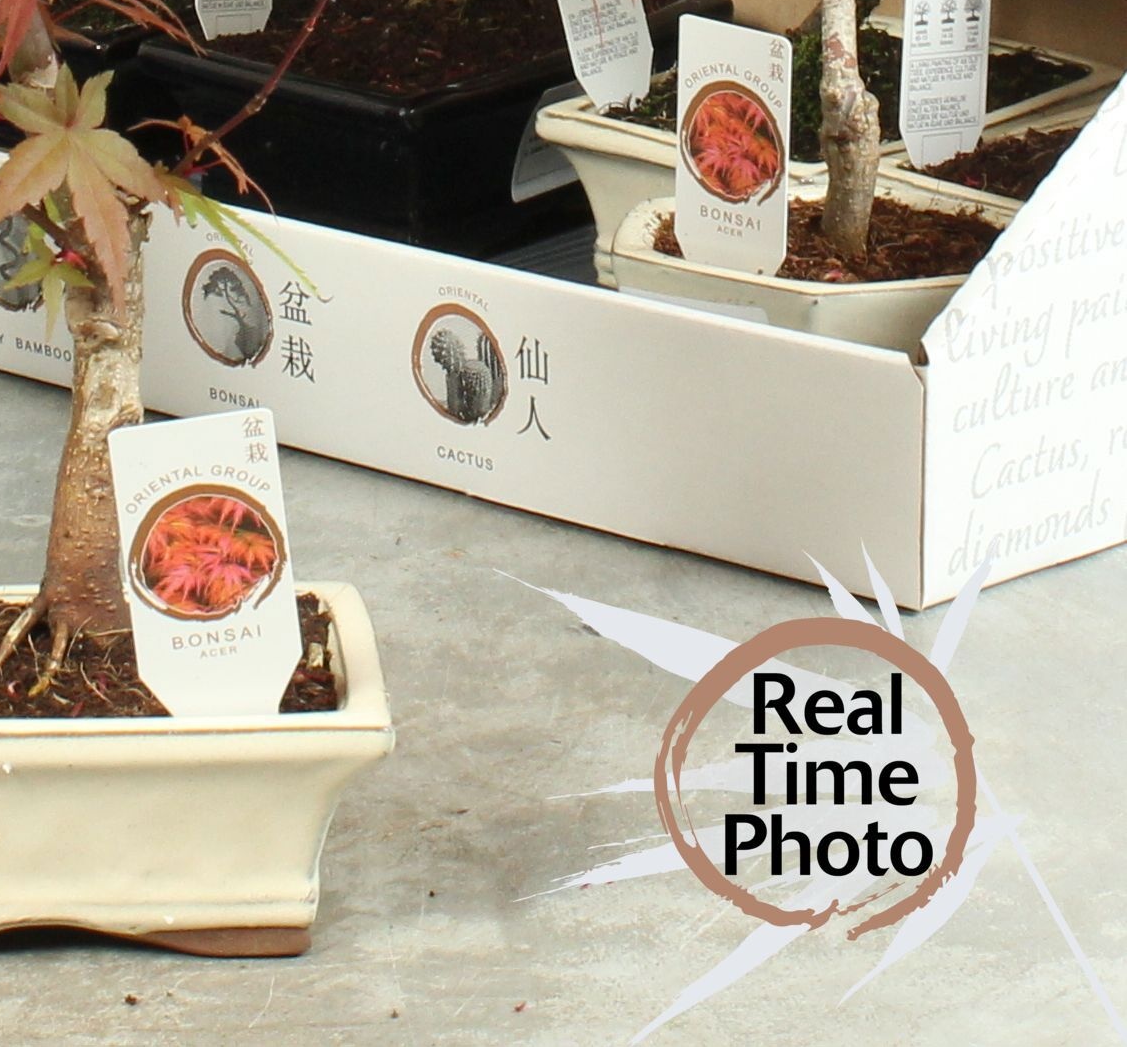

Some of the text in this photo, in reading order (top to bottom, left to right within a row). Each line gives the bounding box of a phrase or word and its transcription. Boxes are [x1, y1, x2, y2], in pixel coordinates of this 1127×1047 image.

[684, 63, 783, 108] ORIENTAL GROUP
[700, 205, 761, 231] BONSAI
[717, 226, 743, 238] ACER
[438, 286, 489, 312] ORIENTAL
[278, 281, 316, 384] 盆栽
[15, 337, 72, 363] BAMBOO
[209, 387, 261, 409] BONSAI
[515, 335, 552, 442] 仙人
[953, 362, 1074, 434] culture
[243, 416, 269, 464] 盆栽
[437, 445, 494, 472] CACTUS
[125, 464, 272, 515] ORIENTAL GROUP
[172, 624, 262, 650] BONSAI
[199, 645, 238, 659] ACER
